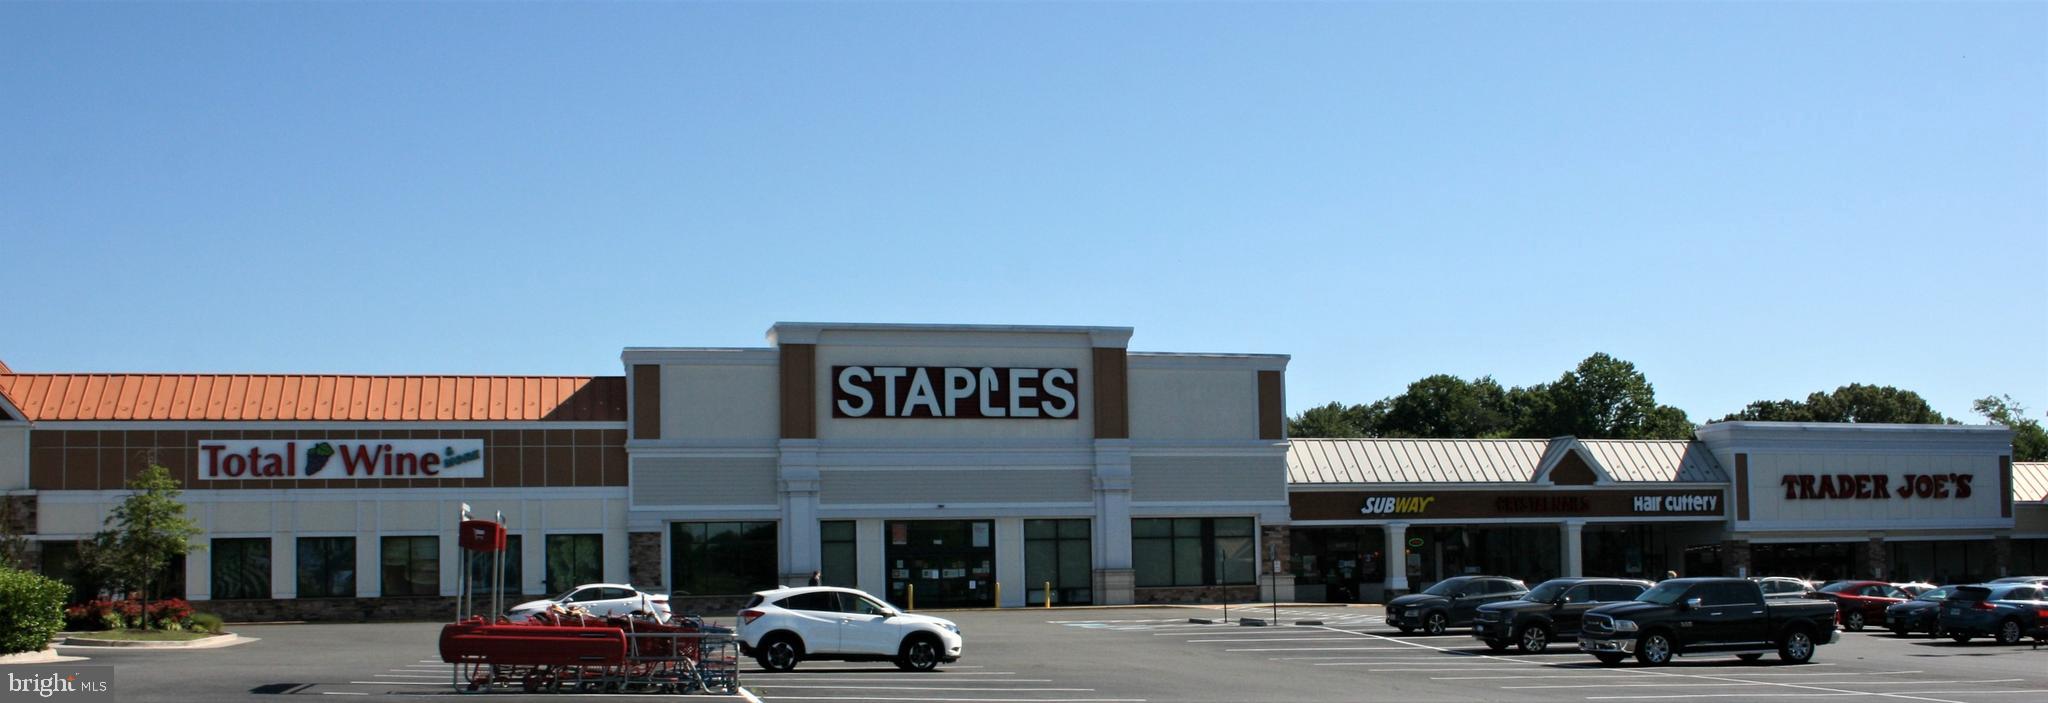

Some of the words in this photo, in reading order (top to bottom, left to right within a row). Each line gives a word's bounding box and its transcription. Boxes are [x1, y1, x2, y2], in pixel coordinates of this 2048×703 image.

[837, 366, 1076, 418] STAPLES
[201, 442, 296, 477] Total
[339, 444, 441, 476] Wine
[1781, 474, 1891, 499] TRADER
[1896, 473, 1974, 499] JOE'S
[1361, 496, 1435, 514] SUBWAY
[1634, 496, 1662, 512] Hair
